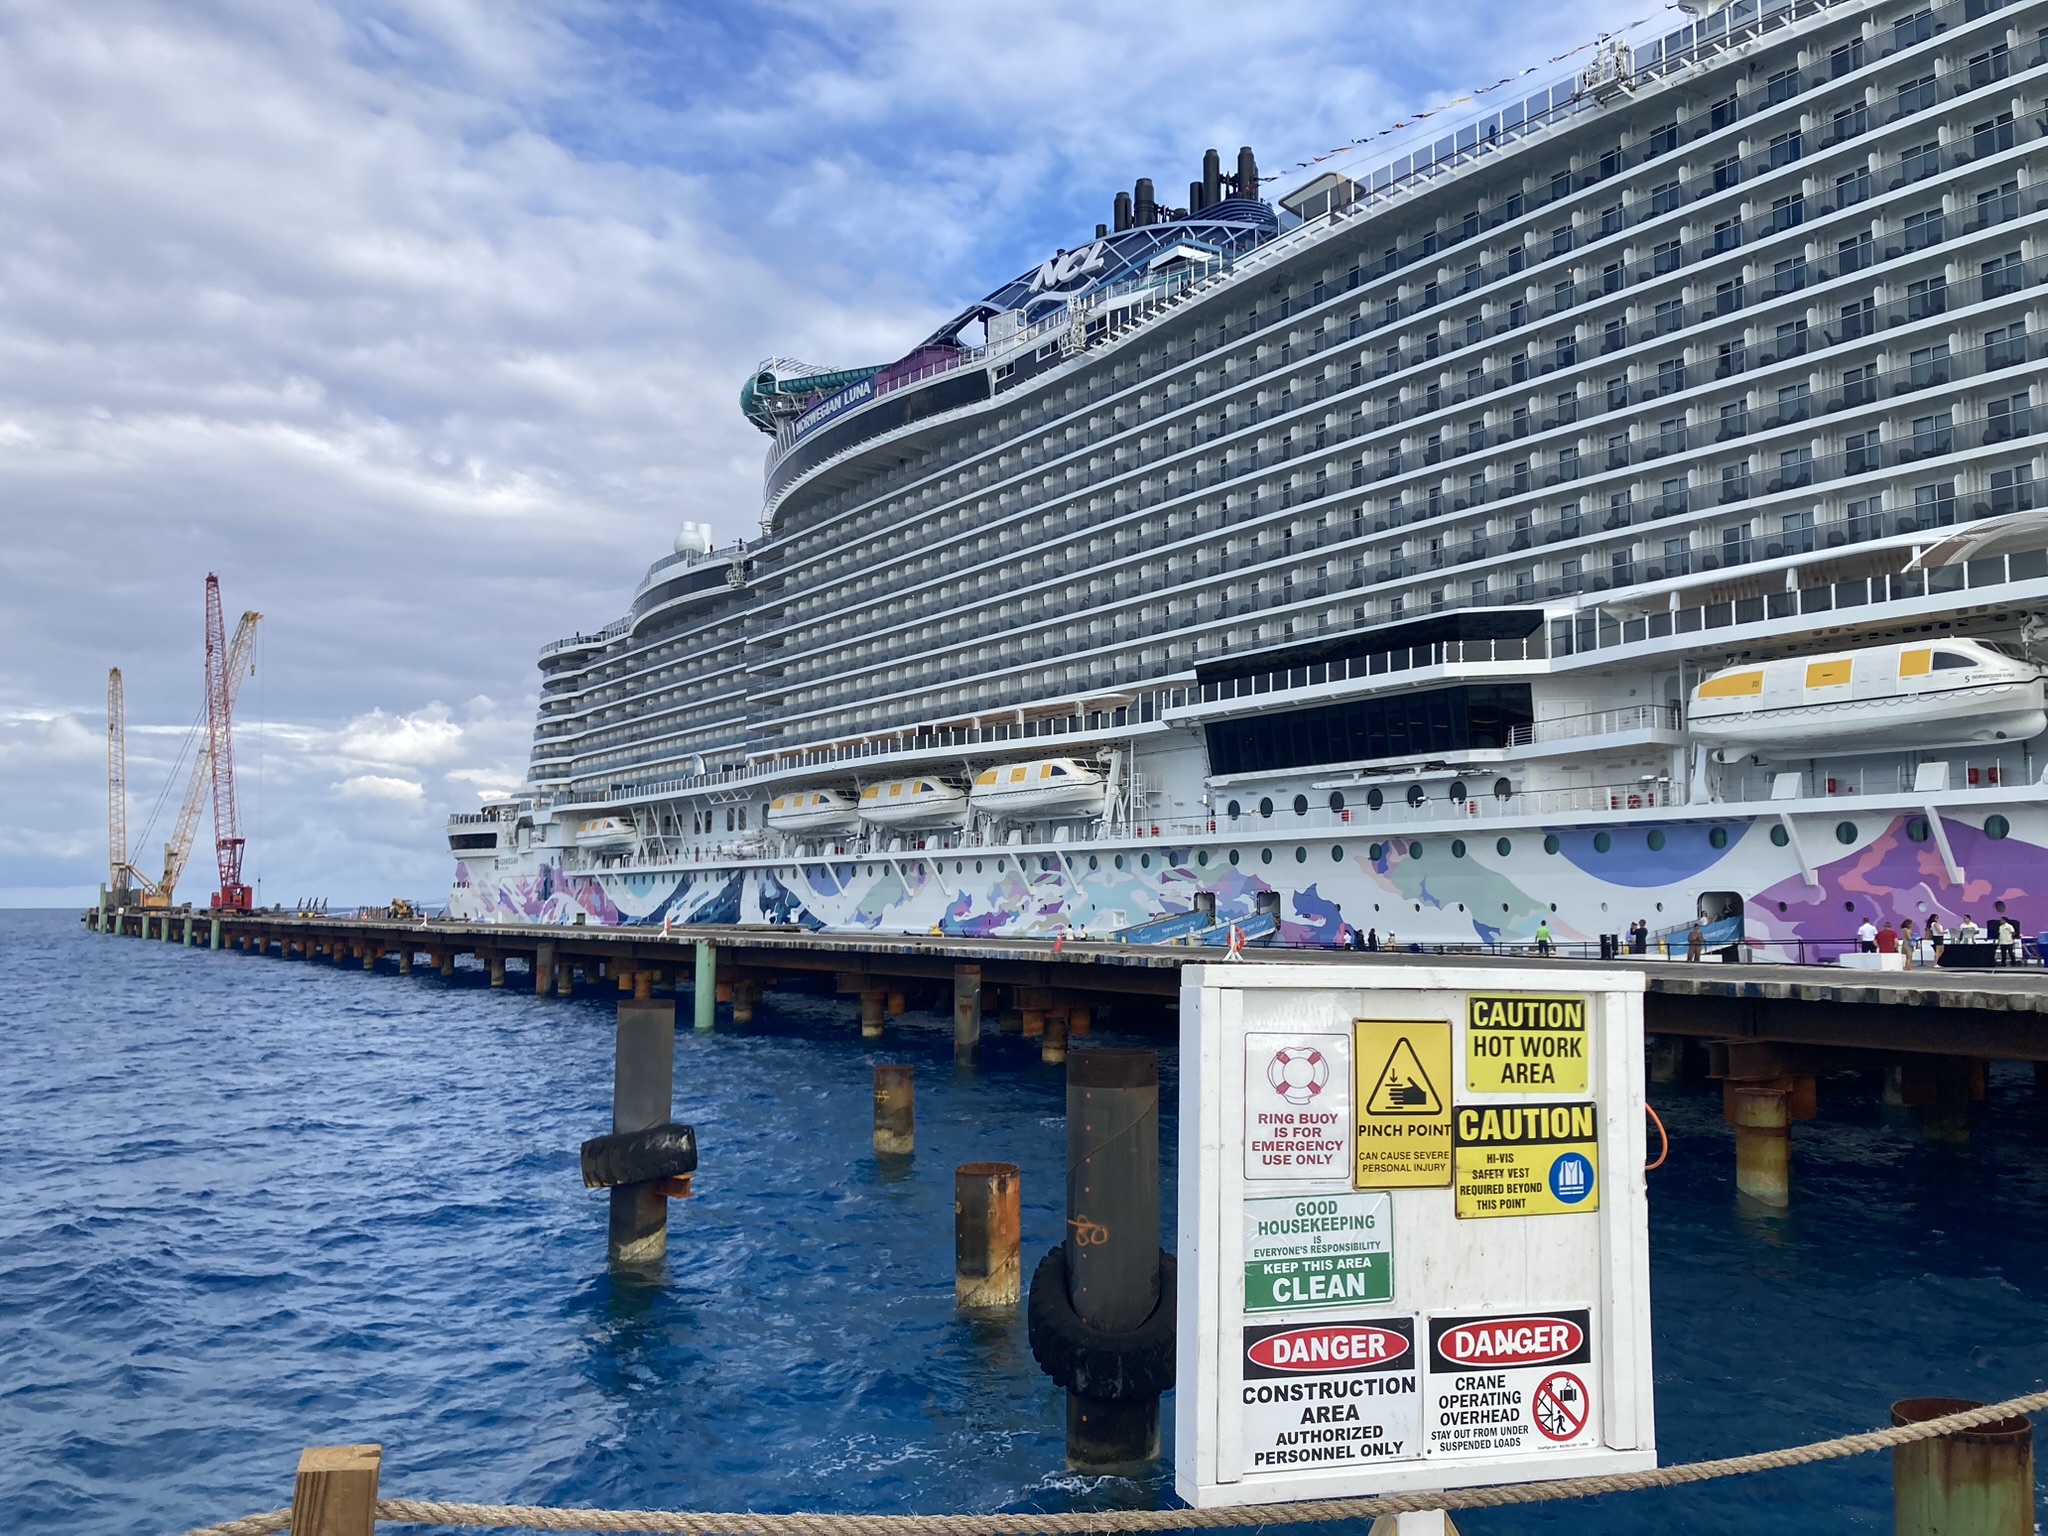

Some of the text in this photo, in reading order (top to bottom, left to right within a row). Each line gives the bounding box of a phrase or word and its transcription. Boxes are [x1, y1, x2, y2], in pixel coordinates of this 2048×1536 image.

[1029, 240, 1104, 294] NCL
[796, 381, 871, 436] NORWEGIAN LUNA
[1473, 1001, 1582, 1028] CAUTION
[1474, 1036, 1582, 1058] HOT WORK
[1501, 1063, 1555, 1084] AREA
[1258, 1113, 1339, 1124] RING BUOY
[1458, 1106, 1593, 1141] CAUTION
[1274, 1127, 1322, 1138] IS FOR
[1358, 1124, 1452, 1137] PINCH POINT
[1252, 1140, 1343, 1151] EMERGENCY
[1262, 1154, 1333, 1165] USE ONLY
[1358, 1151, 1450, 1160] CAN CAUSE SEVERE
[1486, 1153, 1514, 1164] HI-VIS
[1362, 1163, 1446, 1172] PERSONAL INJURY
[1472, 1168, 1530, 1180] SAFETY VEST
[1460, 1182, 1542, 1196] REQUIRED BEYOND
[1296, 1200, 1337, 1216] GOOD
[1477, 1198, 1526, 1210] THIS POINT
[1258, 1215, 1375, 1236] HOUSEKEEPING
[1313, 1235, 1322, 1244] IS
[1254, 1241, 1381, 1257] EVERYONE'S RESPONSIBILITY
[1263, 1257, 1371, 1274] KEEP THIS AREA
[1272, 1272, 1366, 1303] CLEAN
[1273, 1333, 1387, 1363] DANGER
[1455, 1325, 1569, 1358] DANGER
[1243, 1376, 1416, 1404] CONSTRUCTION
[1455, 1375, 1506, 1390] CRANE
[1439, 1391, 1521, 1409] OPERATING
[1300, 1404, 1360, 1424] AREA
[1440, 1408, 1520, 1426] OVERHEAD
[1275, 1425, 1383, 1446] AUTHORIZED
[1431, 1425, 1529, 1440] STAY OUT FROM UNDER
[1439, 1437, 1521, 1452] SUSPENDED LOADS
[1254, 1441, 1404, 1465] PERSONNEL ONLY
